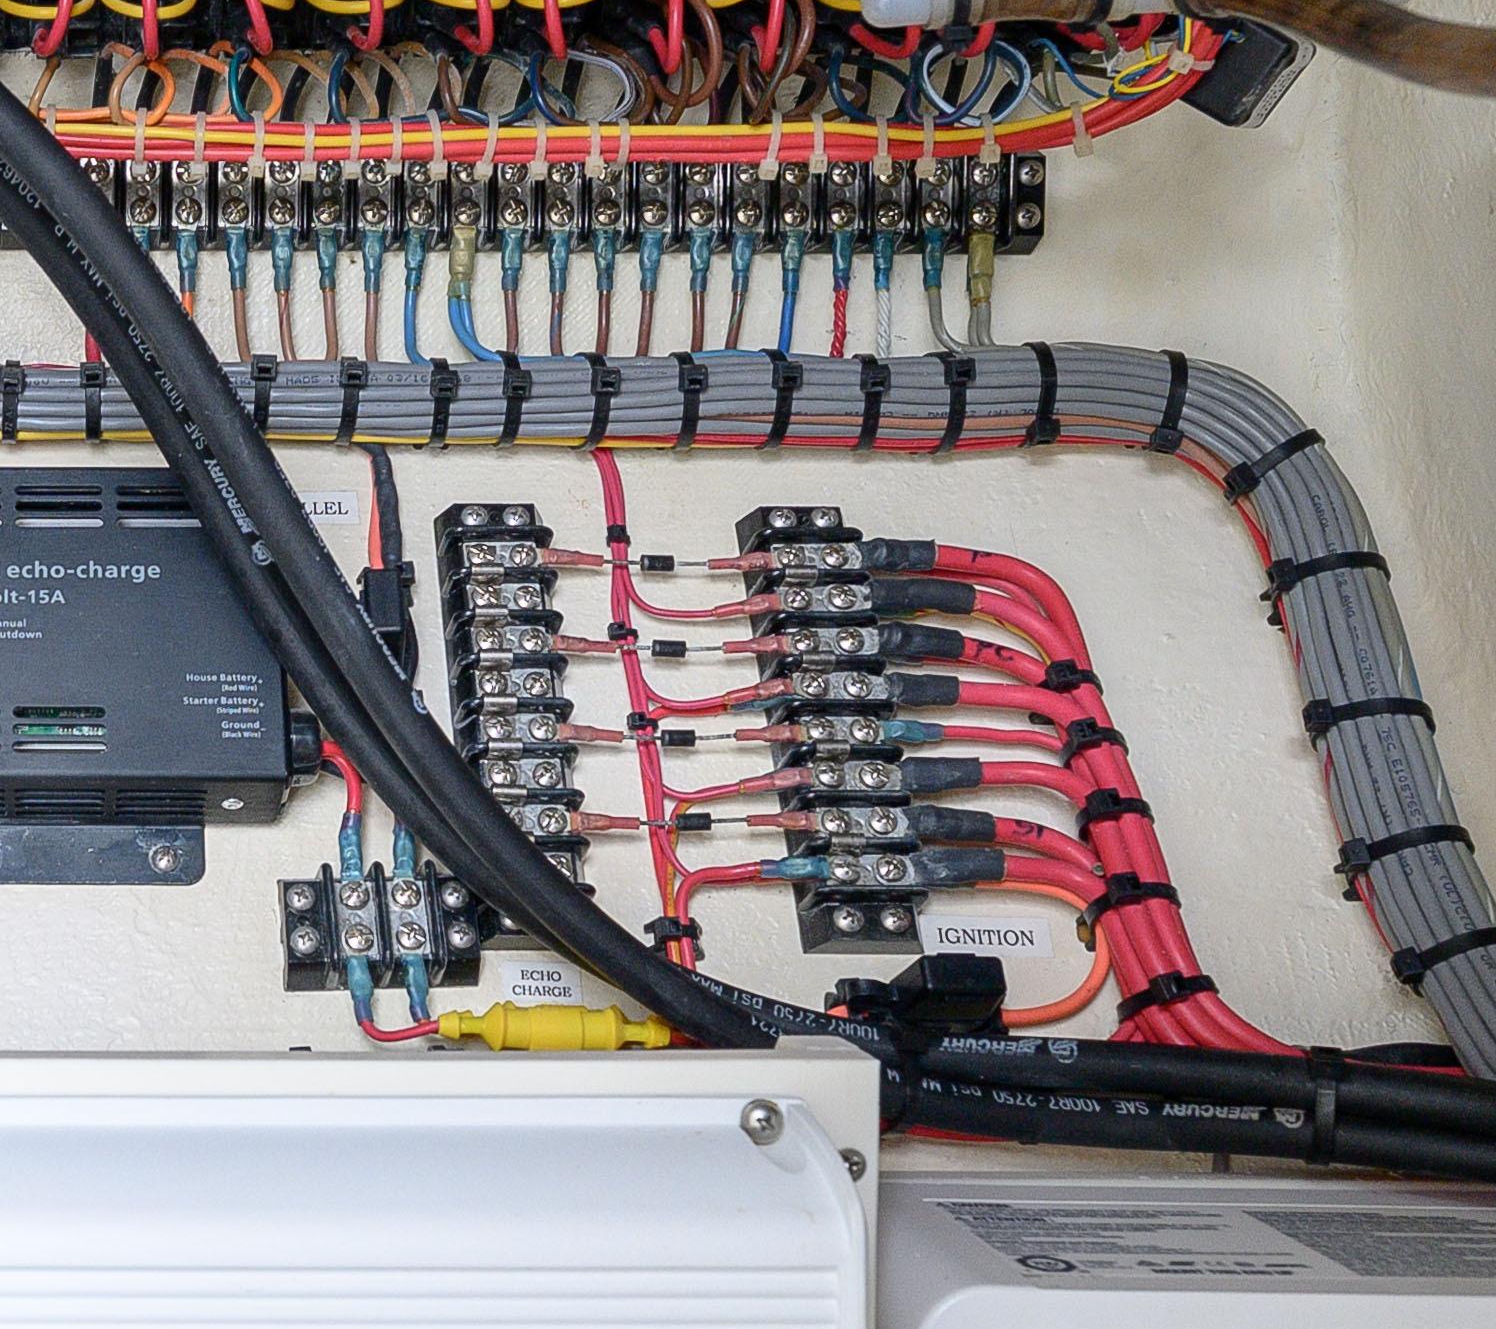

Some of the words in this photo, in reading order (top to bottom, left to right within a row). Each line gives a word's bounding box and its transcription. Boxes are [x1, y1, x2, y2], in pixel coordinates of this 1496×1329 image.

[205, 457, 259, 536] MERCURY
[7, 560, 161, 582] echo-charge
[186, 673, 218, 682] House
[183, 696, 219, 705] Starter
[936, 927, 1036, 947] IGNITION
[520, 969, 562, 983] ECHO
[512, 984, 573, 999] CHARGE
[940, 1037, 1039, 1054] MERCURY
[1116, 1100, 1149, 1116] SAE
[1163, 1103, 1267, 1122] MERCURY
